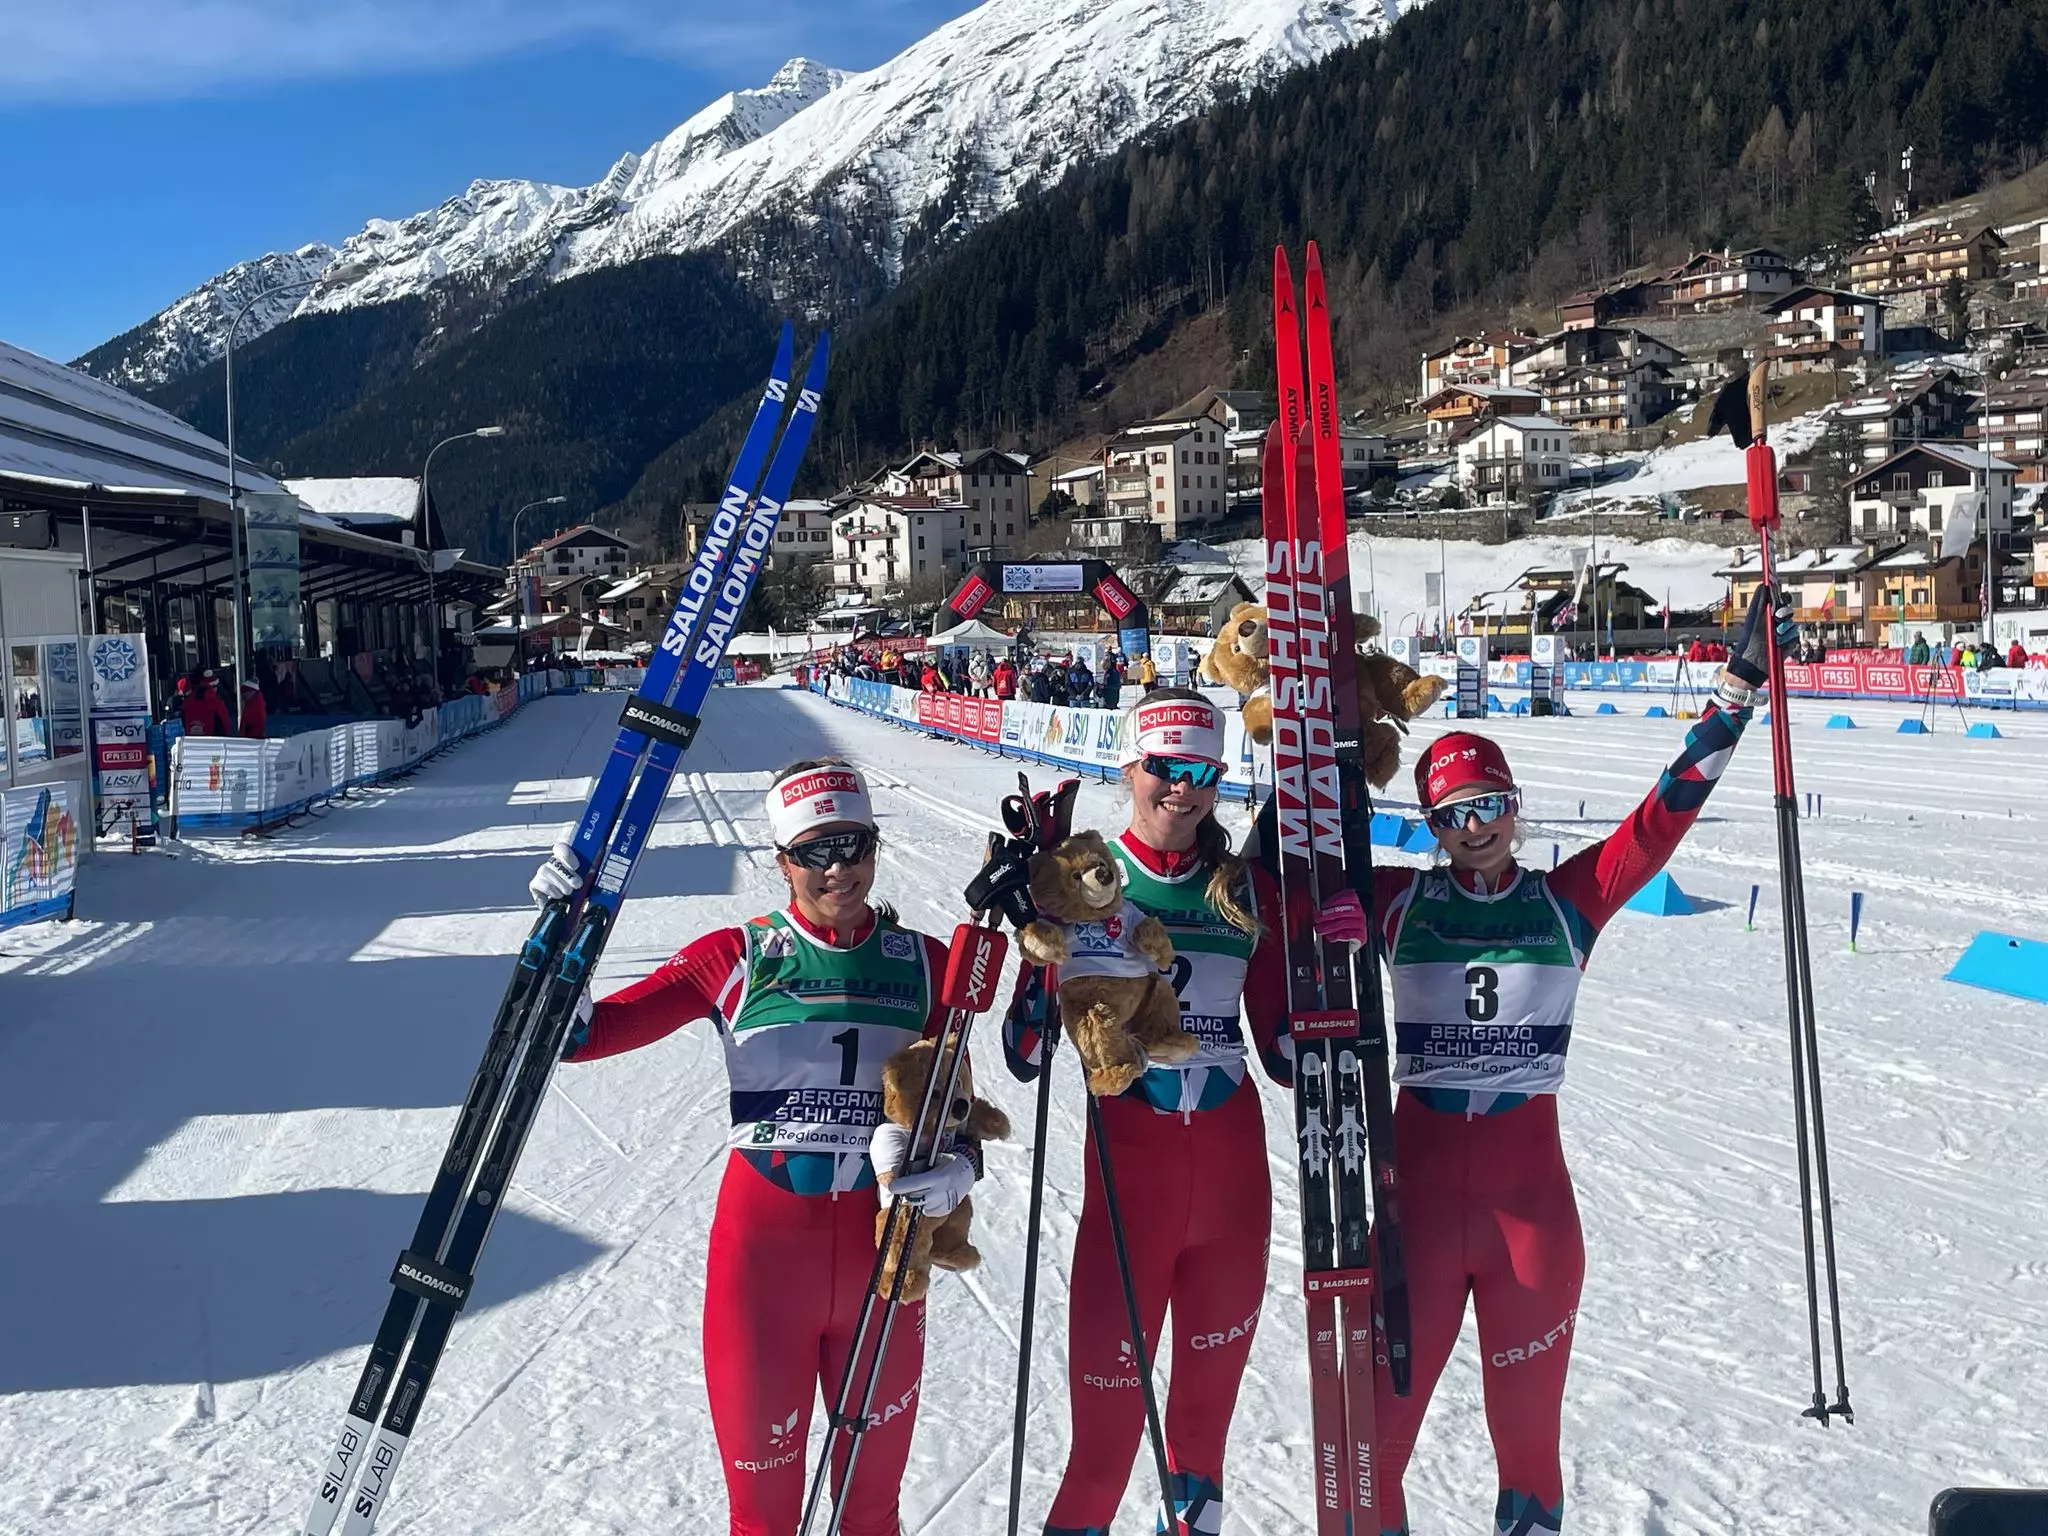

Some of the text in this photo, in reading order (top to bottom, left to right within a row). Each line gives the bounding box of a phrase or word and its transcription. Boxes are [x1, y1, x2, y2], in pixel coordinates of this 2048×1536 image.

[1287, 387, 1300, 445] ATOMIC
[1318, 382, 1331, 440] ATOMIC
[662, 485, 749, 656] SALOMON
[695, 495, 782, 669] SALOMON
[962, 585, 984, 613] FASSI
[1104, 583, 1128, 609] FASSI
[1823, 671, 1854, 685] FASSI
[1869, 672, 1902, 687] FASSI
[1264, 538, 1310, 857] MADSHUS
[1295, 538, 1343, 857] MADSHUS
[114, 725, 143, 737] BGY
[626, 706, 691, 737] SALOMON
[1064, 712, 1089, 746] LISKI
[1140, 709, 1201, 729] equinor
[106, 752, 140, 760] FASSI
[1334, 740, 1358, 748] OMIC
[105, 774, 142, 787] LISKI
[783, 774, 845, 802] equinor
[876, 997, 919, 1011] GRUPPO
[1464, 966, 1499, 1022] 3
[1309, 1019, 1356, 1029] MADSHUS
[1431, 1025, 1532, 1041] BERGAMO
[832, 1028, 860, 1086] 1
[1424, 1041, 1539, 1056] SCHILPARIO
[785, 1089, 882, 1108] BERGAM
[775, 1106, 881, 1126] SCHILPARI
[777, 1128, 838, 1144] Regione
[398, 1263, 465, 1299] SALOMON
[1322, 1278, 1370, 1289] MADSHUS
[1190, 1303, 1262, 1350] CRAFT
[1317, 1331, 1332, 1342] 207
[1352, 1330, 1367, 1341] 207
[1491, 1318, 1569, 1368] CRAFT
[735, 1448, 801, 1474] equinor
[1323, 1442, 1338, 1509] REDLINE
[1358, 1441, 1372, 1508] REDLINE
